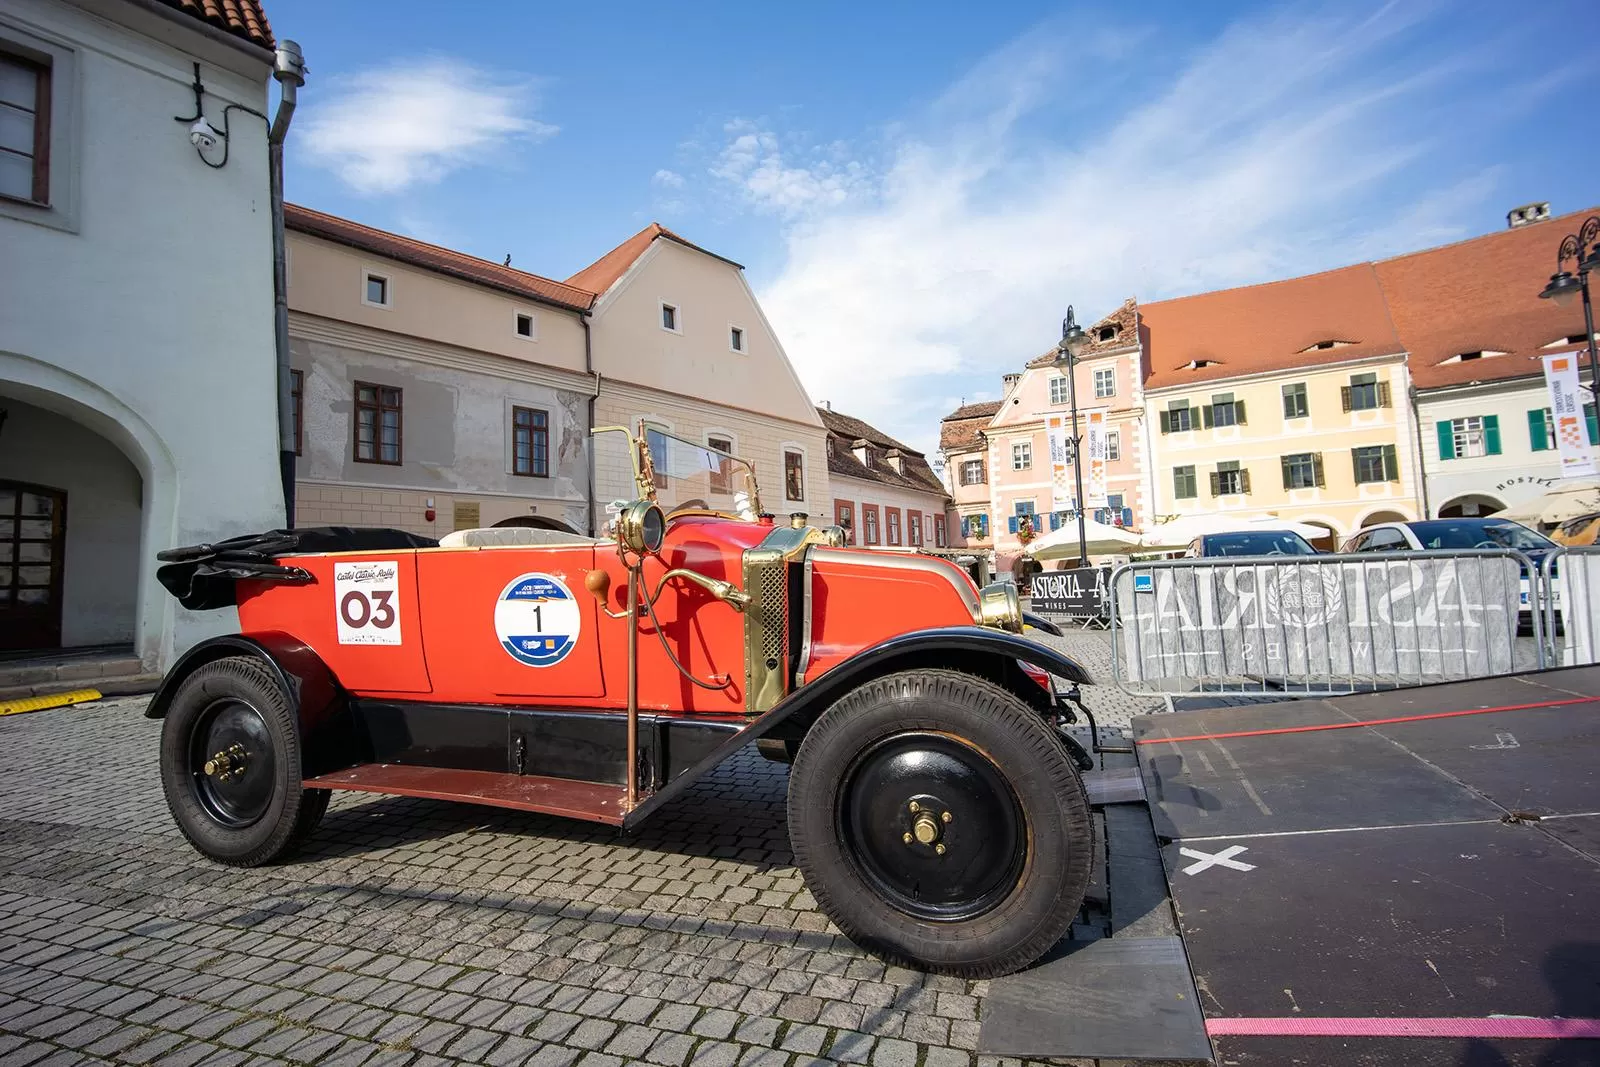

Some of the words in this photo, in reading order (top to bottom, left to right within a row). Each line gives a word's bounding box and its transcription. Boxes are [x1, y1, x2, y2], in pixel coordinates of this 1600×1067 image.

[1496, 476, 1552, 491] HOSTEL
[1031, 574, 1084, 599] ASTORIA
[341, 591, 395, 629] 03
[533, 605, 542, 632] 1
[1045, 602, 1067, 610] WINES
